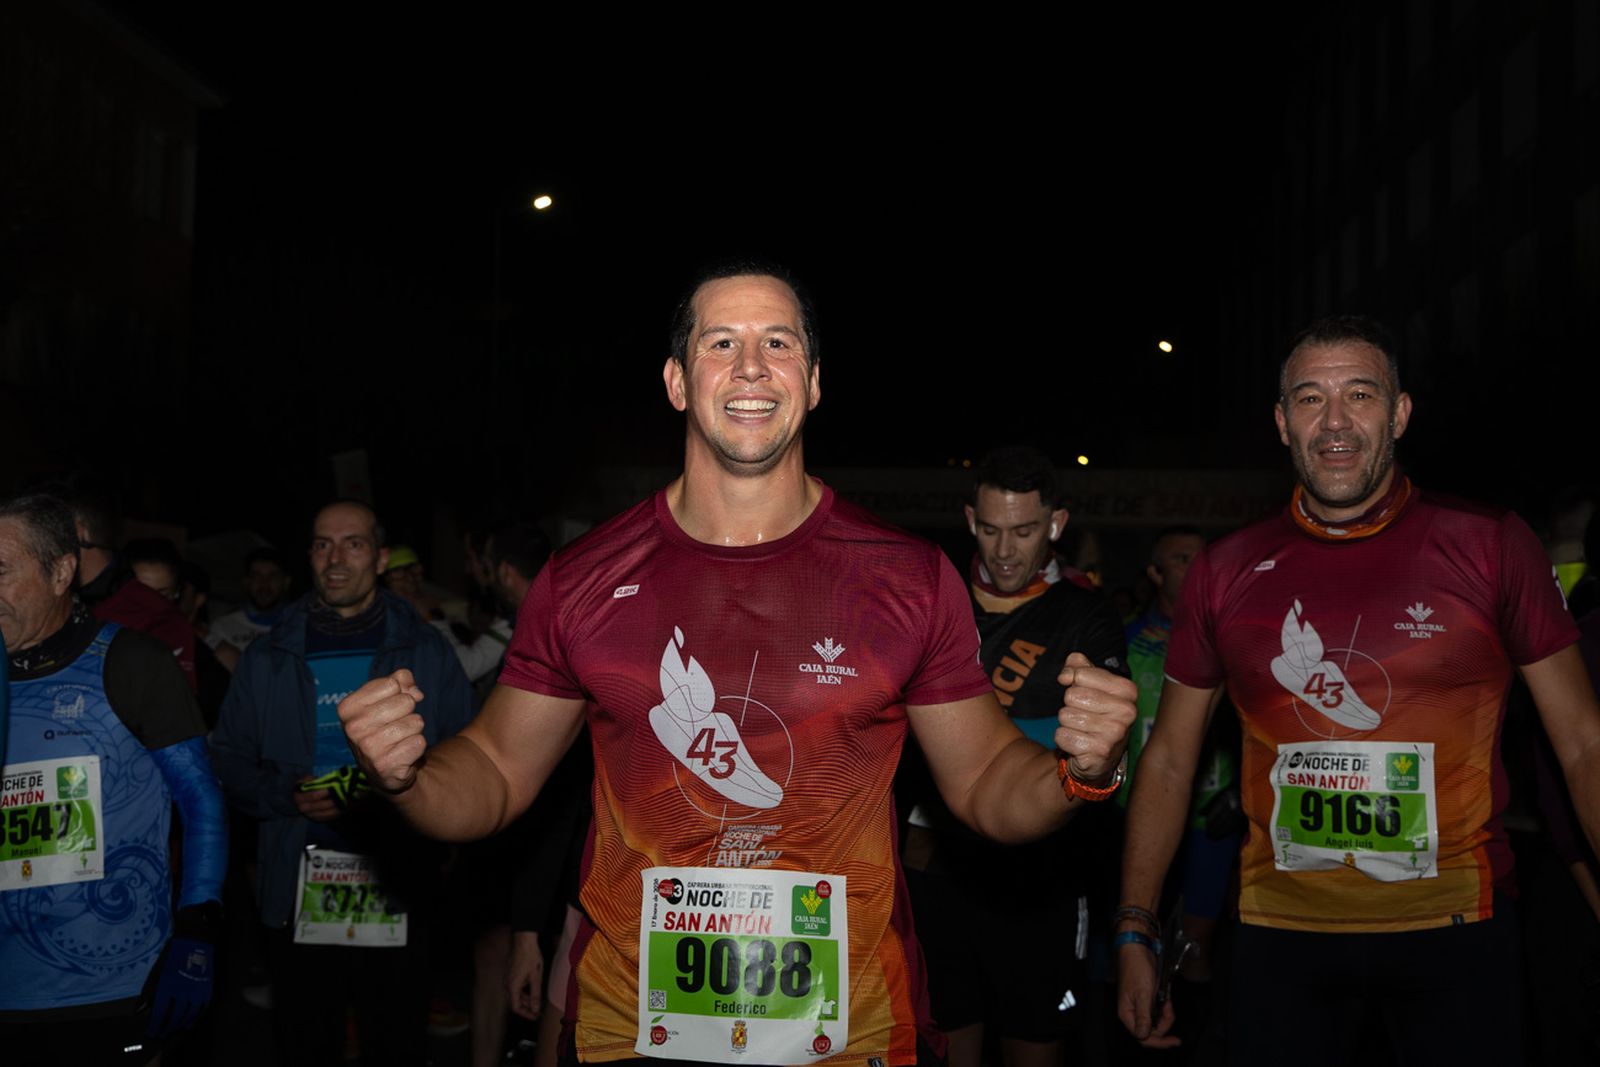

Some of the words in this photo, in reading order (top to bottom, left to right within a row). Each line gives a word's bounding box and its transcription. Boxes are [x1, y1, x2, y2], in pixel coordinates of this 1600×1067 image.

[1417, 623, 1447, 633] RURAL
[825, 665, 858, 677] RURAL
[1303, 673, 1344, 709] 43
[686, 727, 739, 780] 43
[1302, 756, 1347, 771] NOCHE
[1352, 758, 1370, 772] DE
[28, 774, 44, 788] DE
[1287, 773, 1315, 787] SAN
[1319, 771, 1371, 790] ANTÓN
[1, 787, 45, 808] ANTÓN
[1300, 790, 1401, 838] 9166
[0, 802, 71, 847] 547
[718, 837, 760, 850] SAN
[1325, 837, 1352, 850] Angel
[715, 844, 783, 867] ANTÓN
[312, 871, 333, 882] SAN
[686, 889, 746, 909] NOCHE
[750, 891, 774, 910] DE
[664, 911, 702, 932] SAN
[704, 909, 772, 935] ANTÓN
[675, 936, 812, 998] 9088
[714, 1000, 767, 1015] Federico
